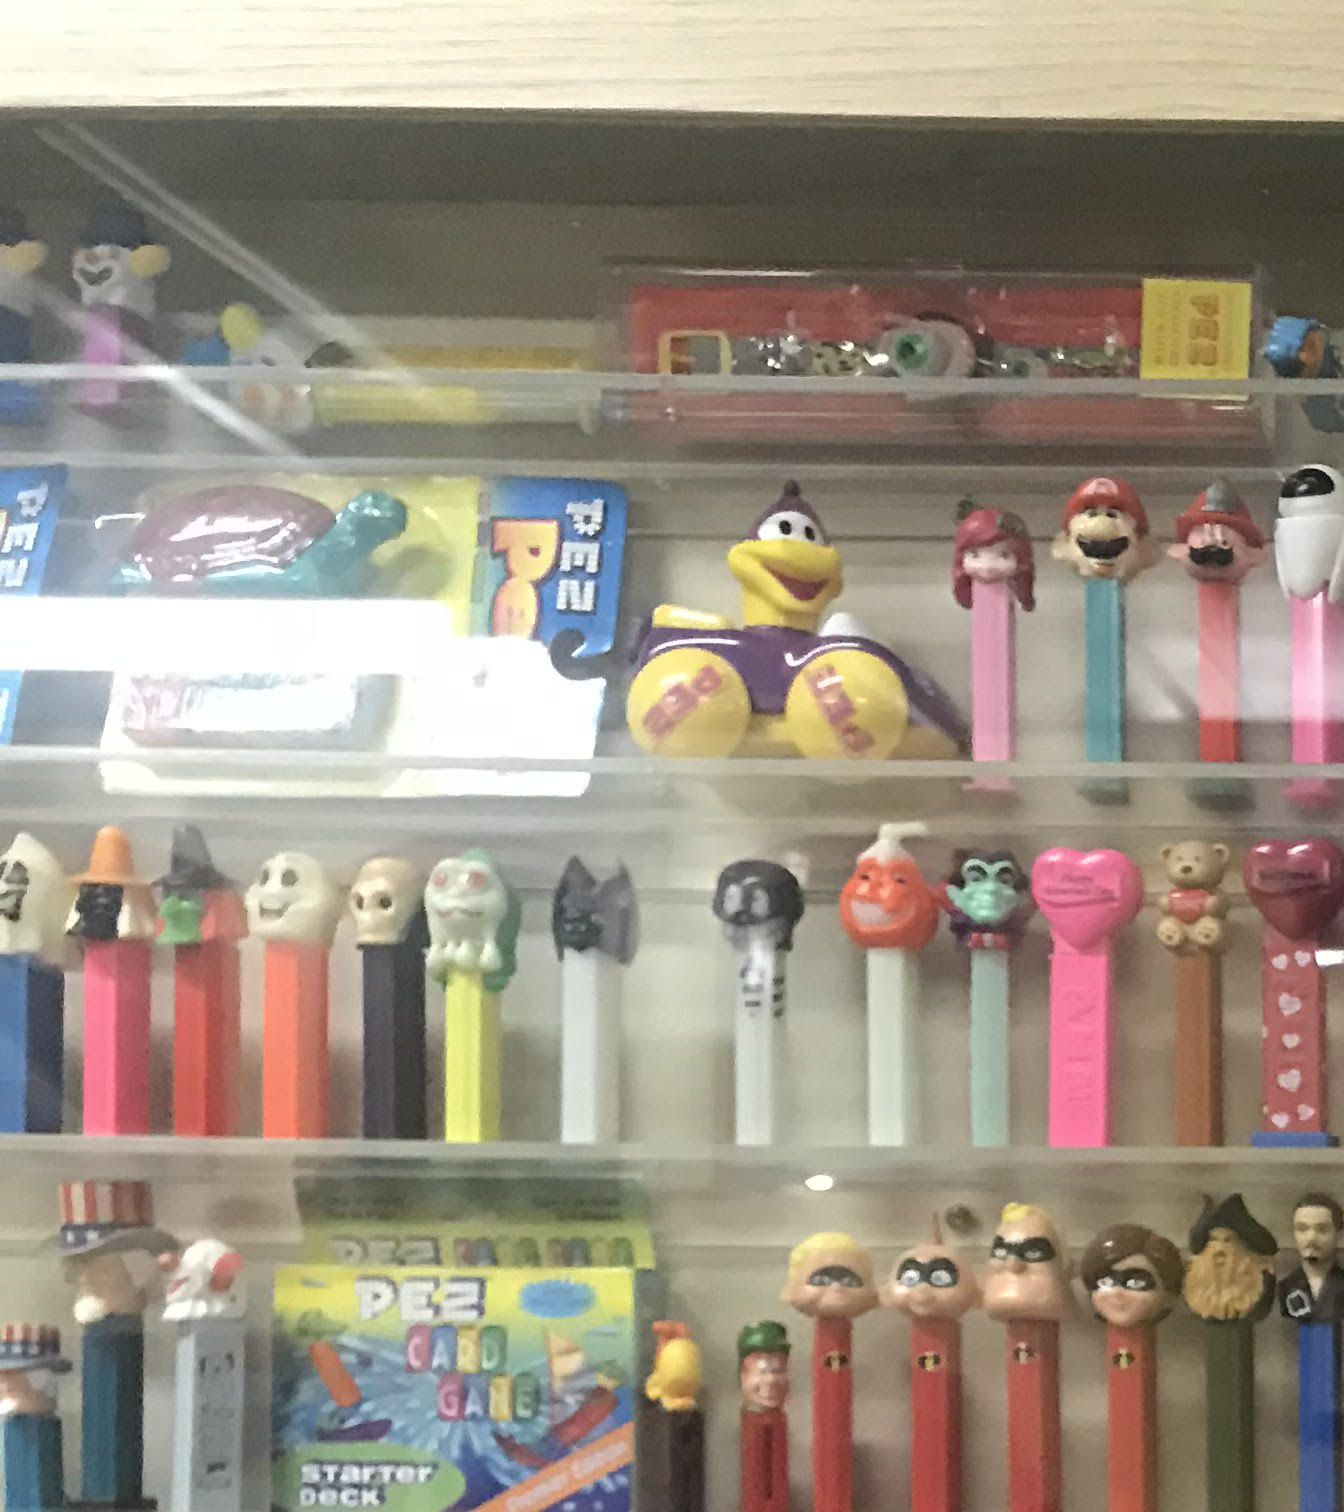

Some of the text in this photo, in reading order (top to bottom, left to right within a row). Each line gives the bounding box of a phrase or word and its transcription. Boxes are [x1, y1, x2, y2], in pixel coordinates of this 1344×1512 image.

[556, 499, 604, 612] PEZ
[355, 1276, 485, 1321] PEZ
[407, 1329, 505, 1372] CARD
[439, 1375, 537, 1420] GAME
